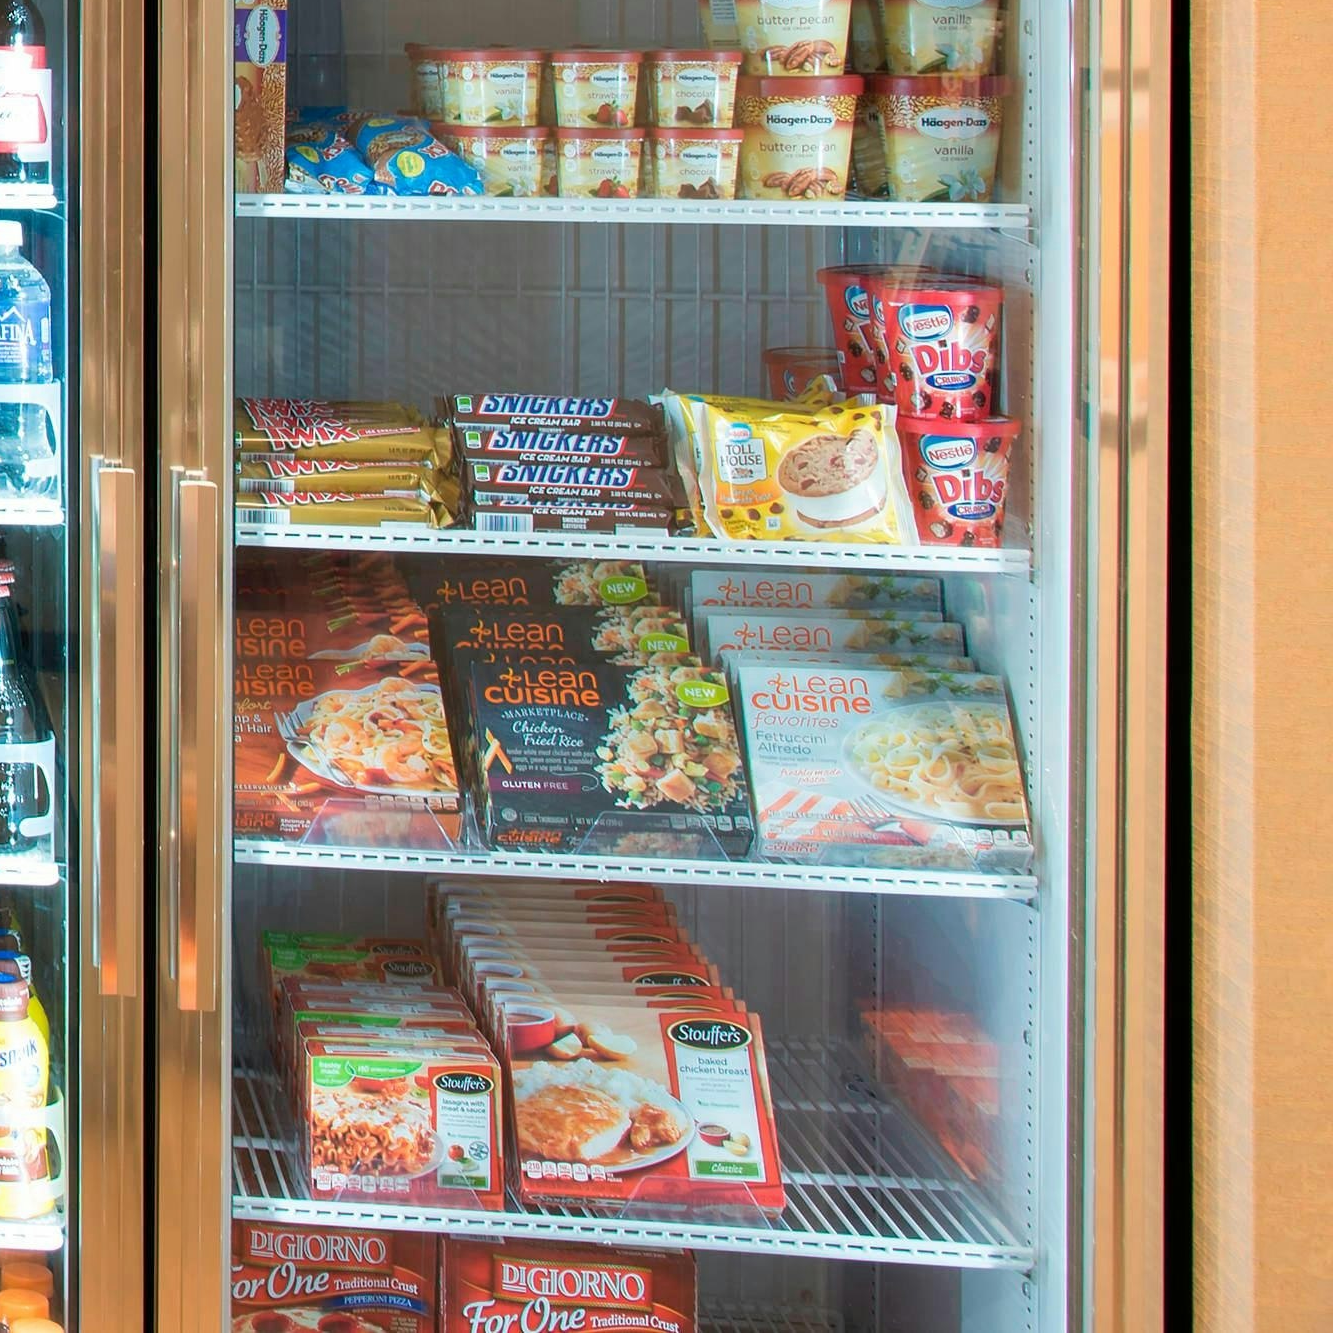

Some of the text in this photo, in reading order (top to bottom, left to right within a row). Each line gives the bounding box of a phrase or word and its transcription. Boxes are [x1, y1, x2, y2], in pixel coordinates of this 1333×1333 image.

[757, 13, 796, 25] butter
[932, 14, 972, 25] vanilla
[675, 89, 715, 99] chocolat
[765, 114, 833, 127] Häagen-Dazs
[921, 116, 987, 128] Häagen-Dazs
[759, 141, 798, 153] butter
[933, 144, 975, 155] vanilla
[682, 152, 718, 160] Häagen-Daz
[679, 168, 717, 177] chocolat
[914, 340, 988, 374] Dibs
[935, 374, 970, 385] CRUNCH
[483, 394, 616, 418] SNICKERS
[509, 416, 581, 427] ICE CREAM BAR
[263, 425, 360, 452] TWIX
[492, 431, 625, 455] SNICKERS
[725, 444, 755, 455] TOLL
[519, 452, 591, 465] ICE CREAM BAR
[720, 454, 763, 467] HOUSE
[502, 465, 634, 488] SNICKERS
[528, 485, 601, 497] ICE CREAM BAR
[935, 468, 1006, 503] Dibs
[532, 508, 605, 517] ICE CREAM BAR
[459, 577, 528, 600] Lean
[607, 583, 636, 595] NEW
[742, 580, 813, 602] Lean
[236, 617, 306, 638] Lean
[493, 621, 565, 643] Lean
[759, 625, 832, 647] Lean
[235, 637, 307, 658] isine
[645, 640, 678, 651] NEW
[243, 663, 315, 680] Lean
[525, 669, 598, 689] Lean
[792, 675, 870, 696] Lean
[235, 680, 317, 697] uisine
[684, 686, 717, 699] NEW
[503, 707, 585, 722] MARKETPLACE
[751, 711, 839, 729] favorites
[247, 724, 272, 733] Hair
[512, 720, 565, 734] Chicken
[522, 732, 584, 747] Fried Rice
[756, 730, 827, 744] Fettuccini
[757, 742, 812, 755] Alfredo
[501, 780, 569, 790] GLUTEN FREE
[677, 1024, 742, 1047] Stouffer's
[698, 1056, 728, 1066] baked
[679, 1065, 749, 1076] chicken breast
[440, 1074, 486, 1092] Stouffer's
[442, 1098, 485, 1108] lasagna with
[267, 1261, 330, 1299] One
[333, 1276, 419, 1295] Traditional Crust
[344, 1294, 413, 1308] PEPPERONI PIZZA
[462, 1296, 586, 1333] For One
[589, 1312, 680, 1333] Traditional Crust
